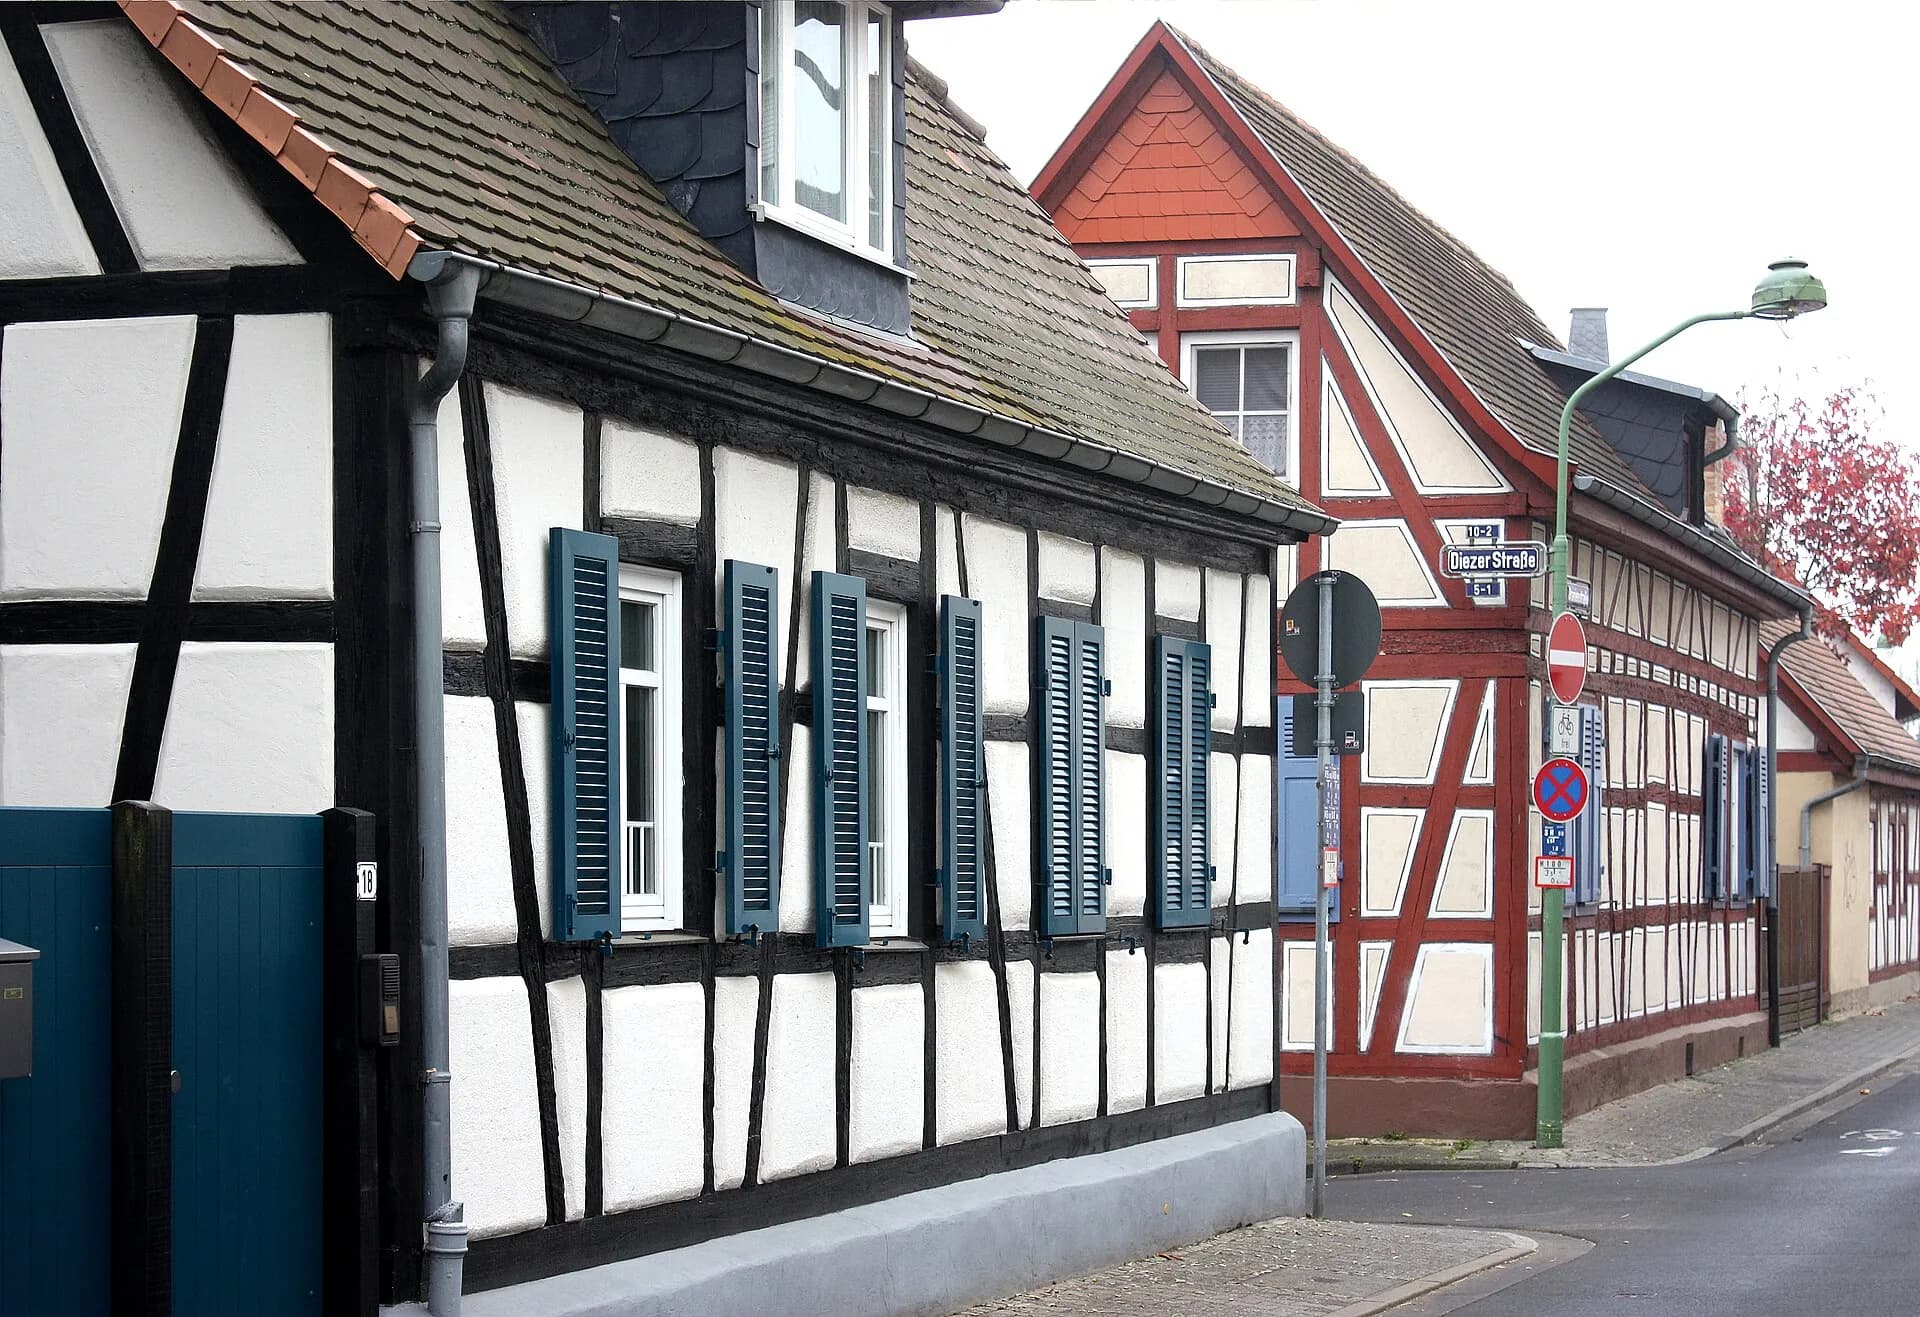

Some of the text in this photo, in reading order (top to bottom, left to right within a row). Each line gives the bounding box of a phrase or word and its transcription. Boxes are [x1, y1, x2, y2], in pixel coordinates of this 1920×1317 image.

[1468, 525, 1492, 537] 10-2
[1450, 551, 1536, 570] Diezer Straße
[1473, 584, 1491, 595] 5-1
[362, 869, 373, 894] 18
